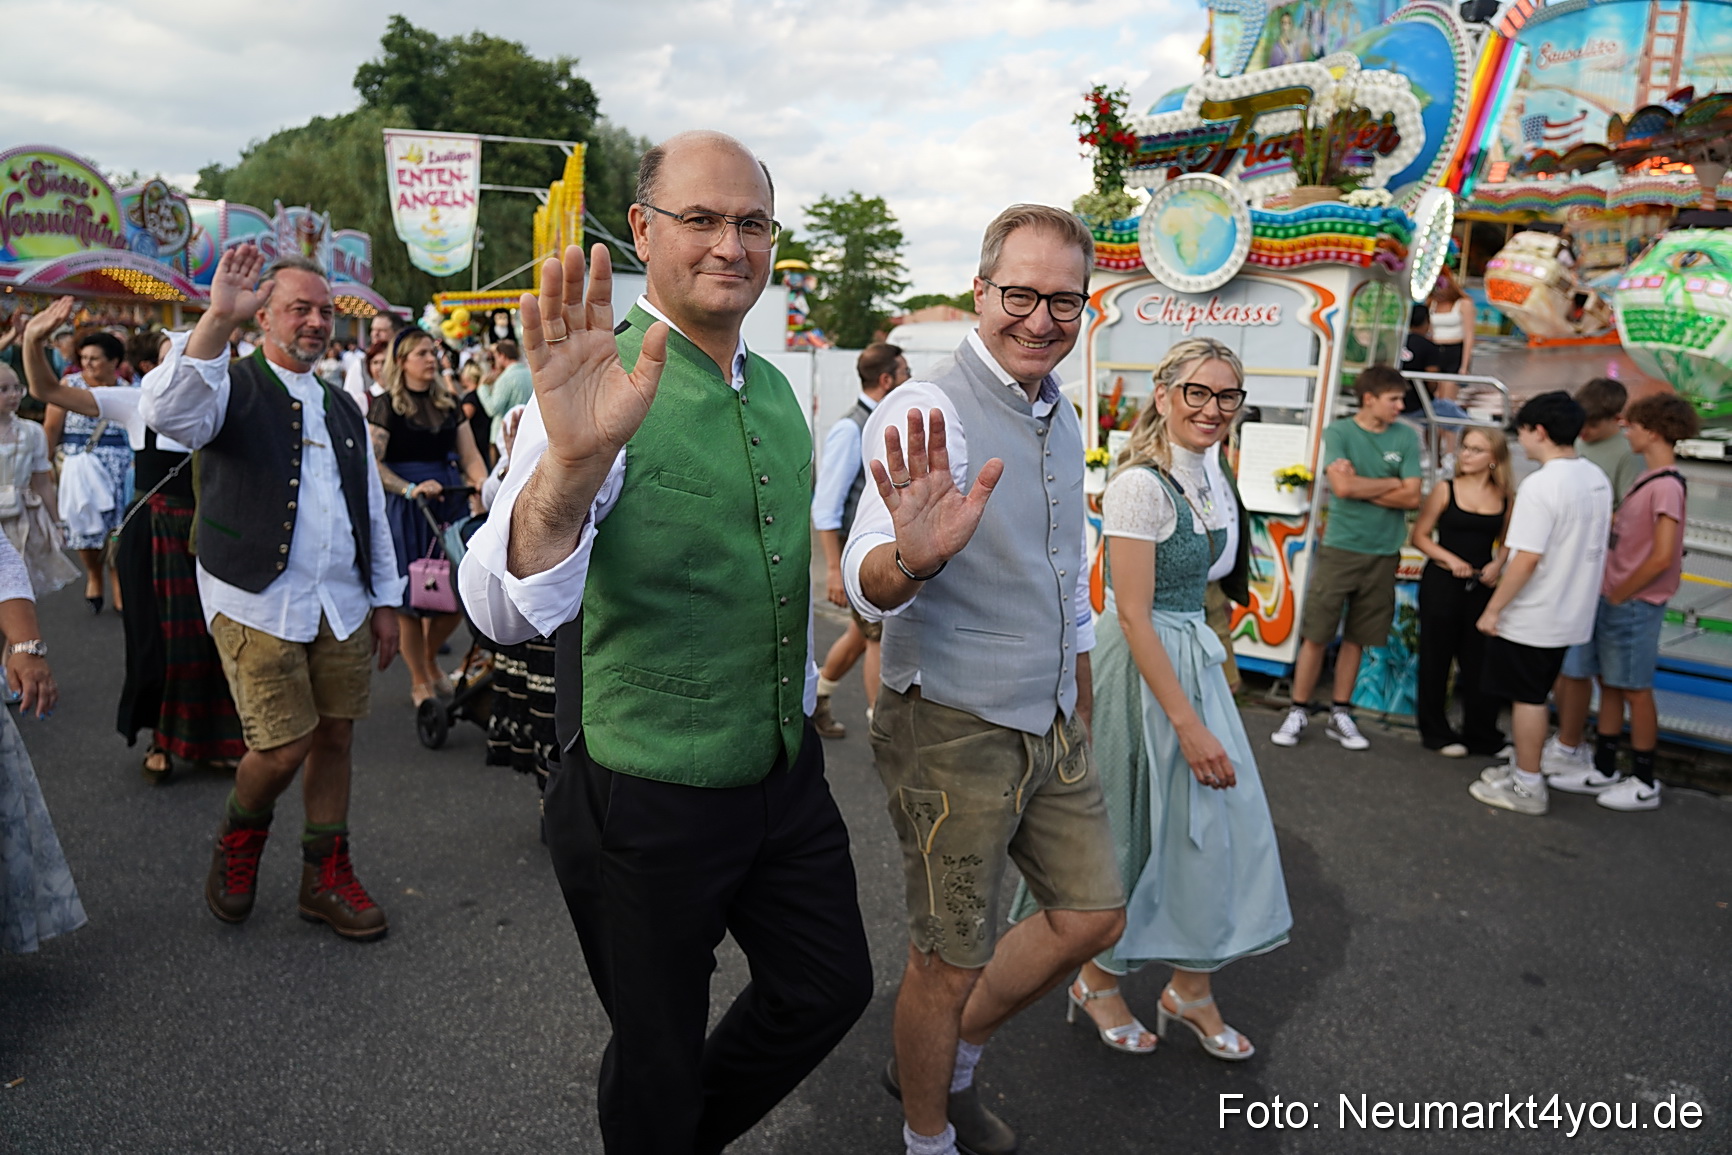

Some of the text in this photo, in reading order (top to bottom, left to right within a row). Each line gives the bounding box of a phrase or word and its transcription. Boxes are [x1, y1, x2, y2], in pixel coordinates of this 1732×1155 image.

[397, 168, 469, 188] ENTEN-
[397, 189, 476, 211] ANGELN
[1135, 296, 1282, 334] Chipkasse
